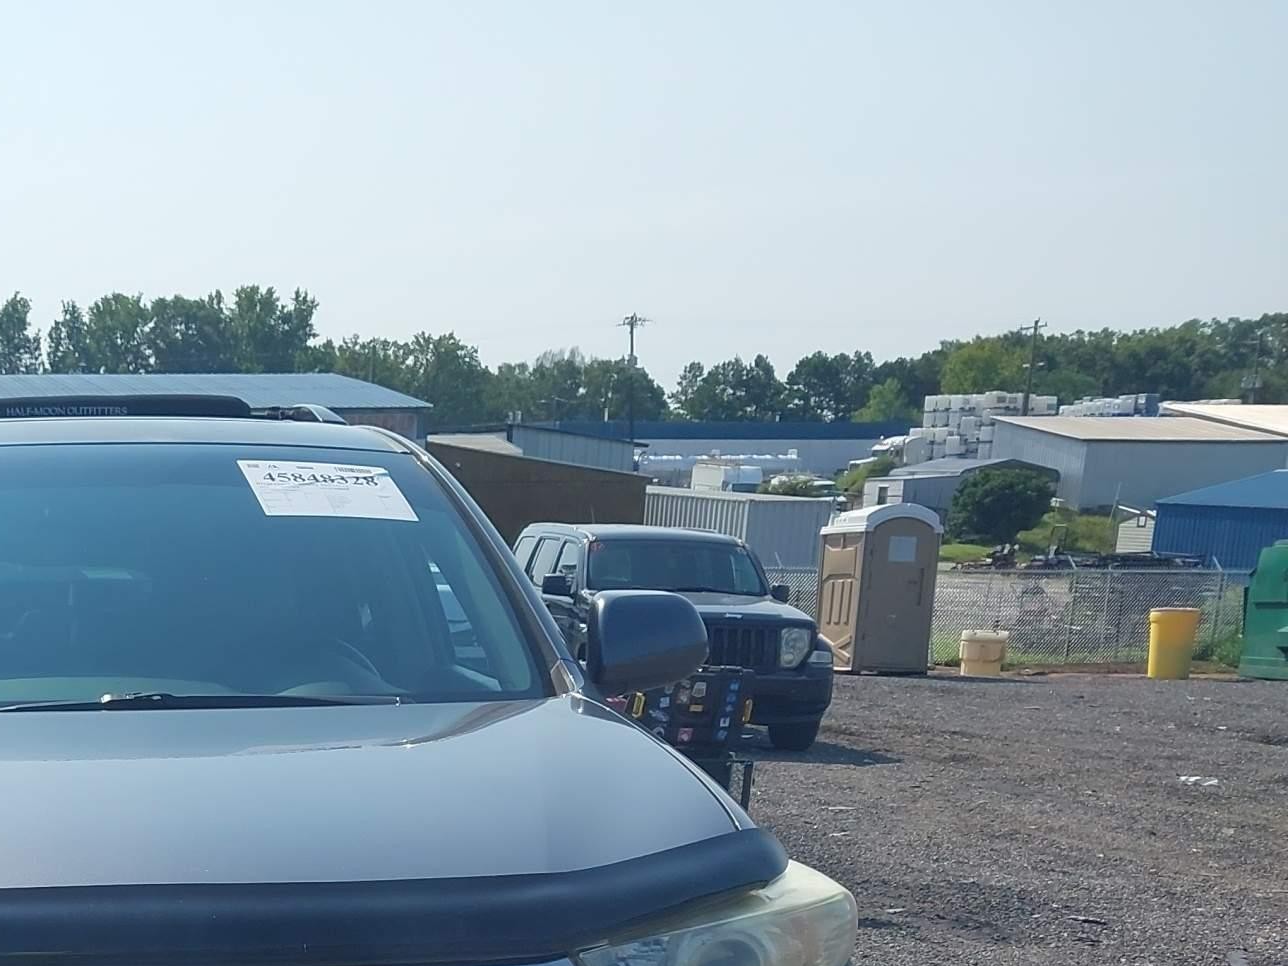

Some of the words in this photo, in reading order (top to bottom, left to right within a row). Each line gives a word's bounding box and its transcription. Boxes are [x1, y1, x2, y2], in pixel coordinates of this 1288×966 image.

[6, 406, 66, 417] HALF-MOON
[67, 406, 128, 416] OUTFITTERS
[263, 471, 379, 487] 45848328
